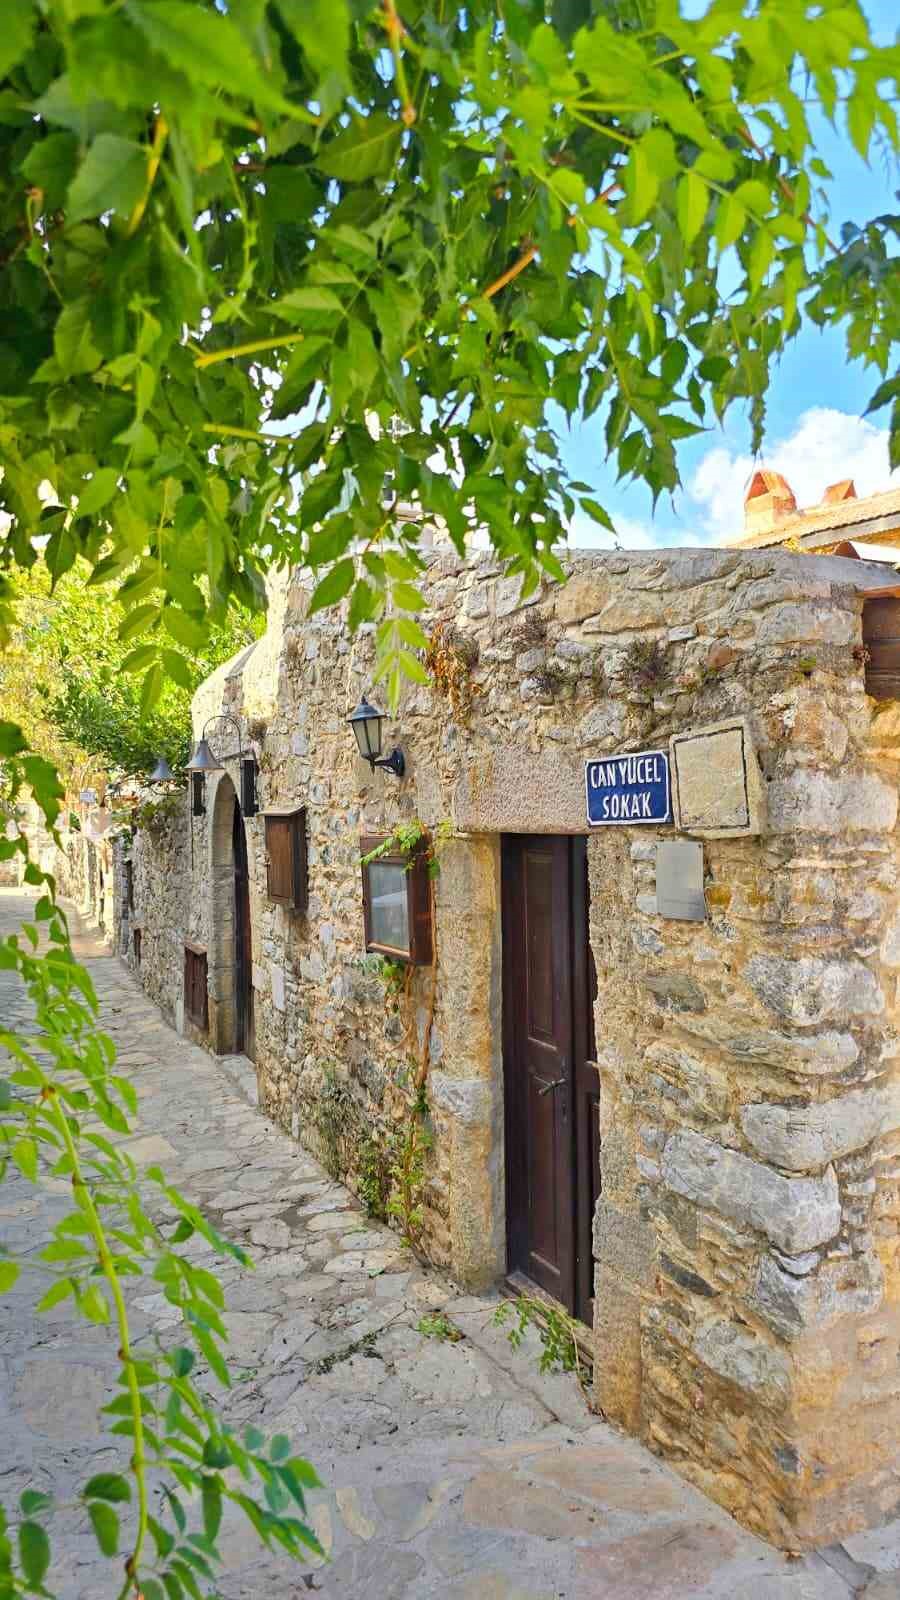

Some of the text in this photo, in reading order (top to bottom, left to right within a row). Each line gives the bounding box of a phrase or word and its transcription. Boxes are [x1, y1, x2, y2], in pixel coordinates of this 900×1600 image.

[590, 757, 661, 788] CAN YÜCEL
[603, 792, 652, 818] SOKAK
